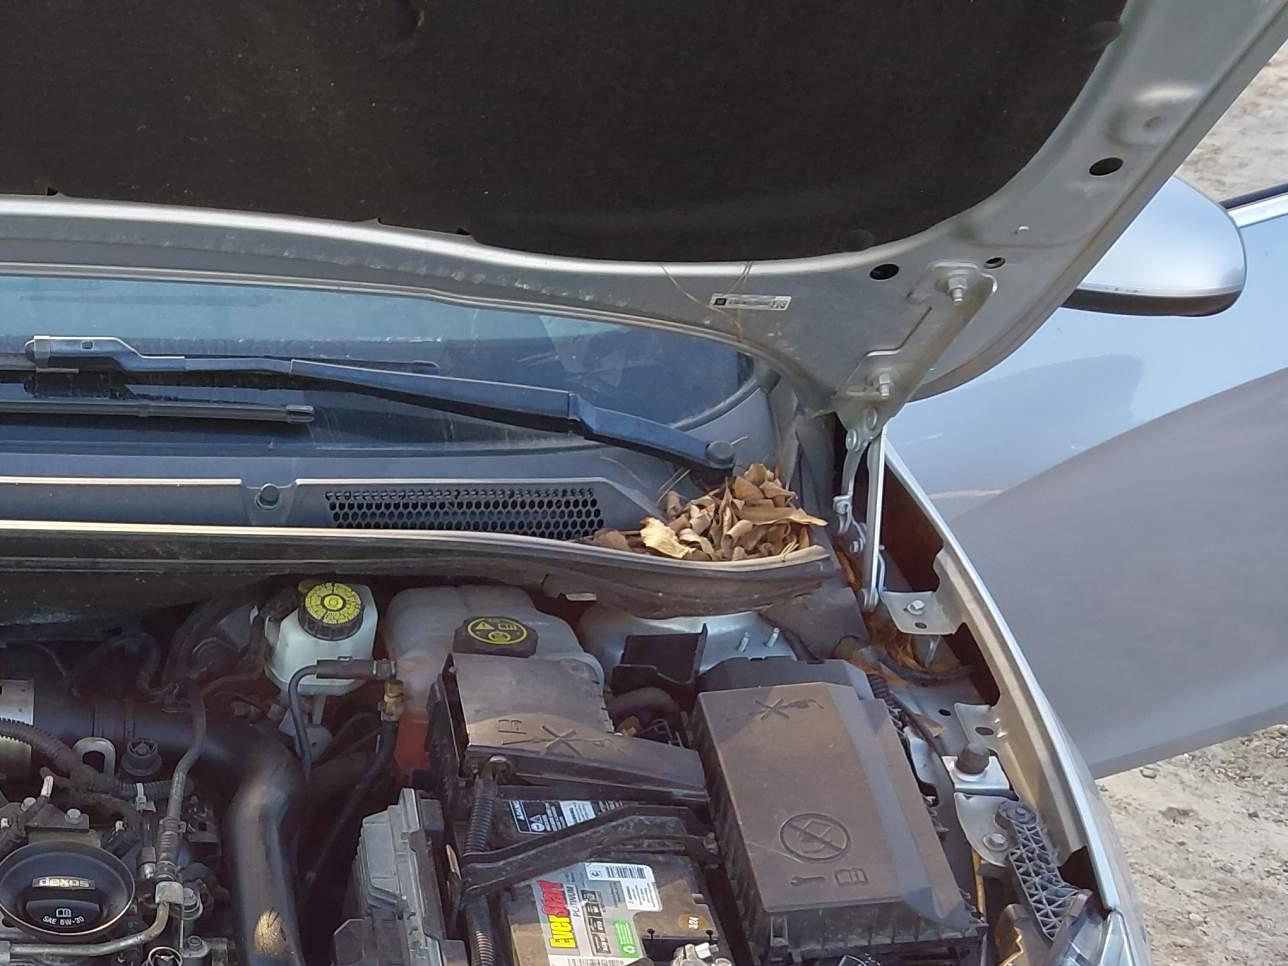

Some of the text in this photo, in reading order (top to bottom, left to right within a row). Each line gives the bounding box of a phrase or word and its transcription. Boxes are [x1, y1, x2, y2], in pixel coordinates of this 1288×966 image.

[39, 877, 90, 888] dexos
[566, 885, 581, 918] PLATINUM
[42, 915, 57, 925] SAE
[536, 880, 578, 949] EverStart
